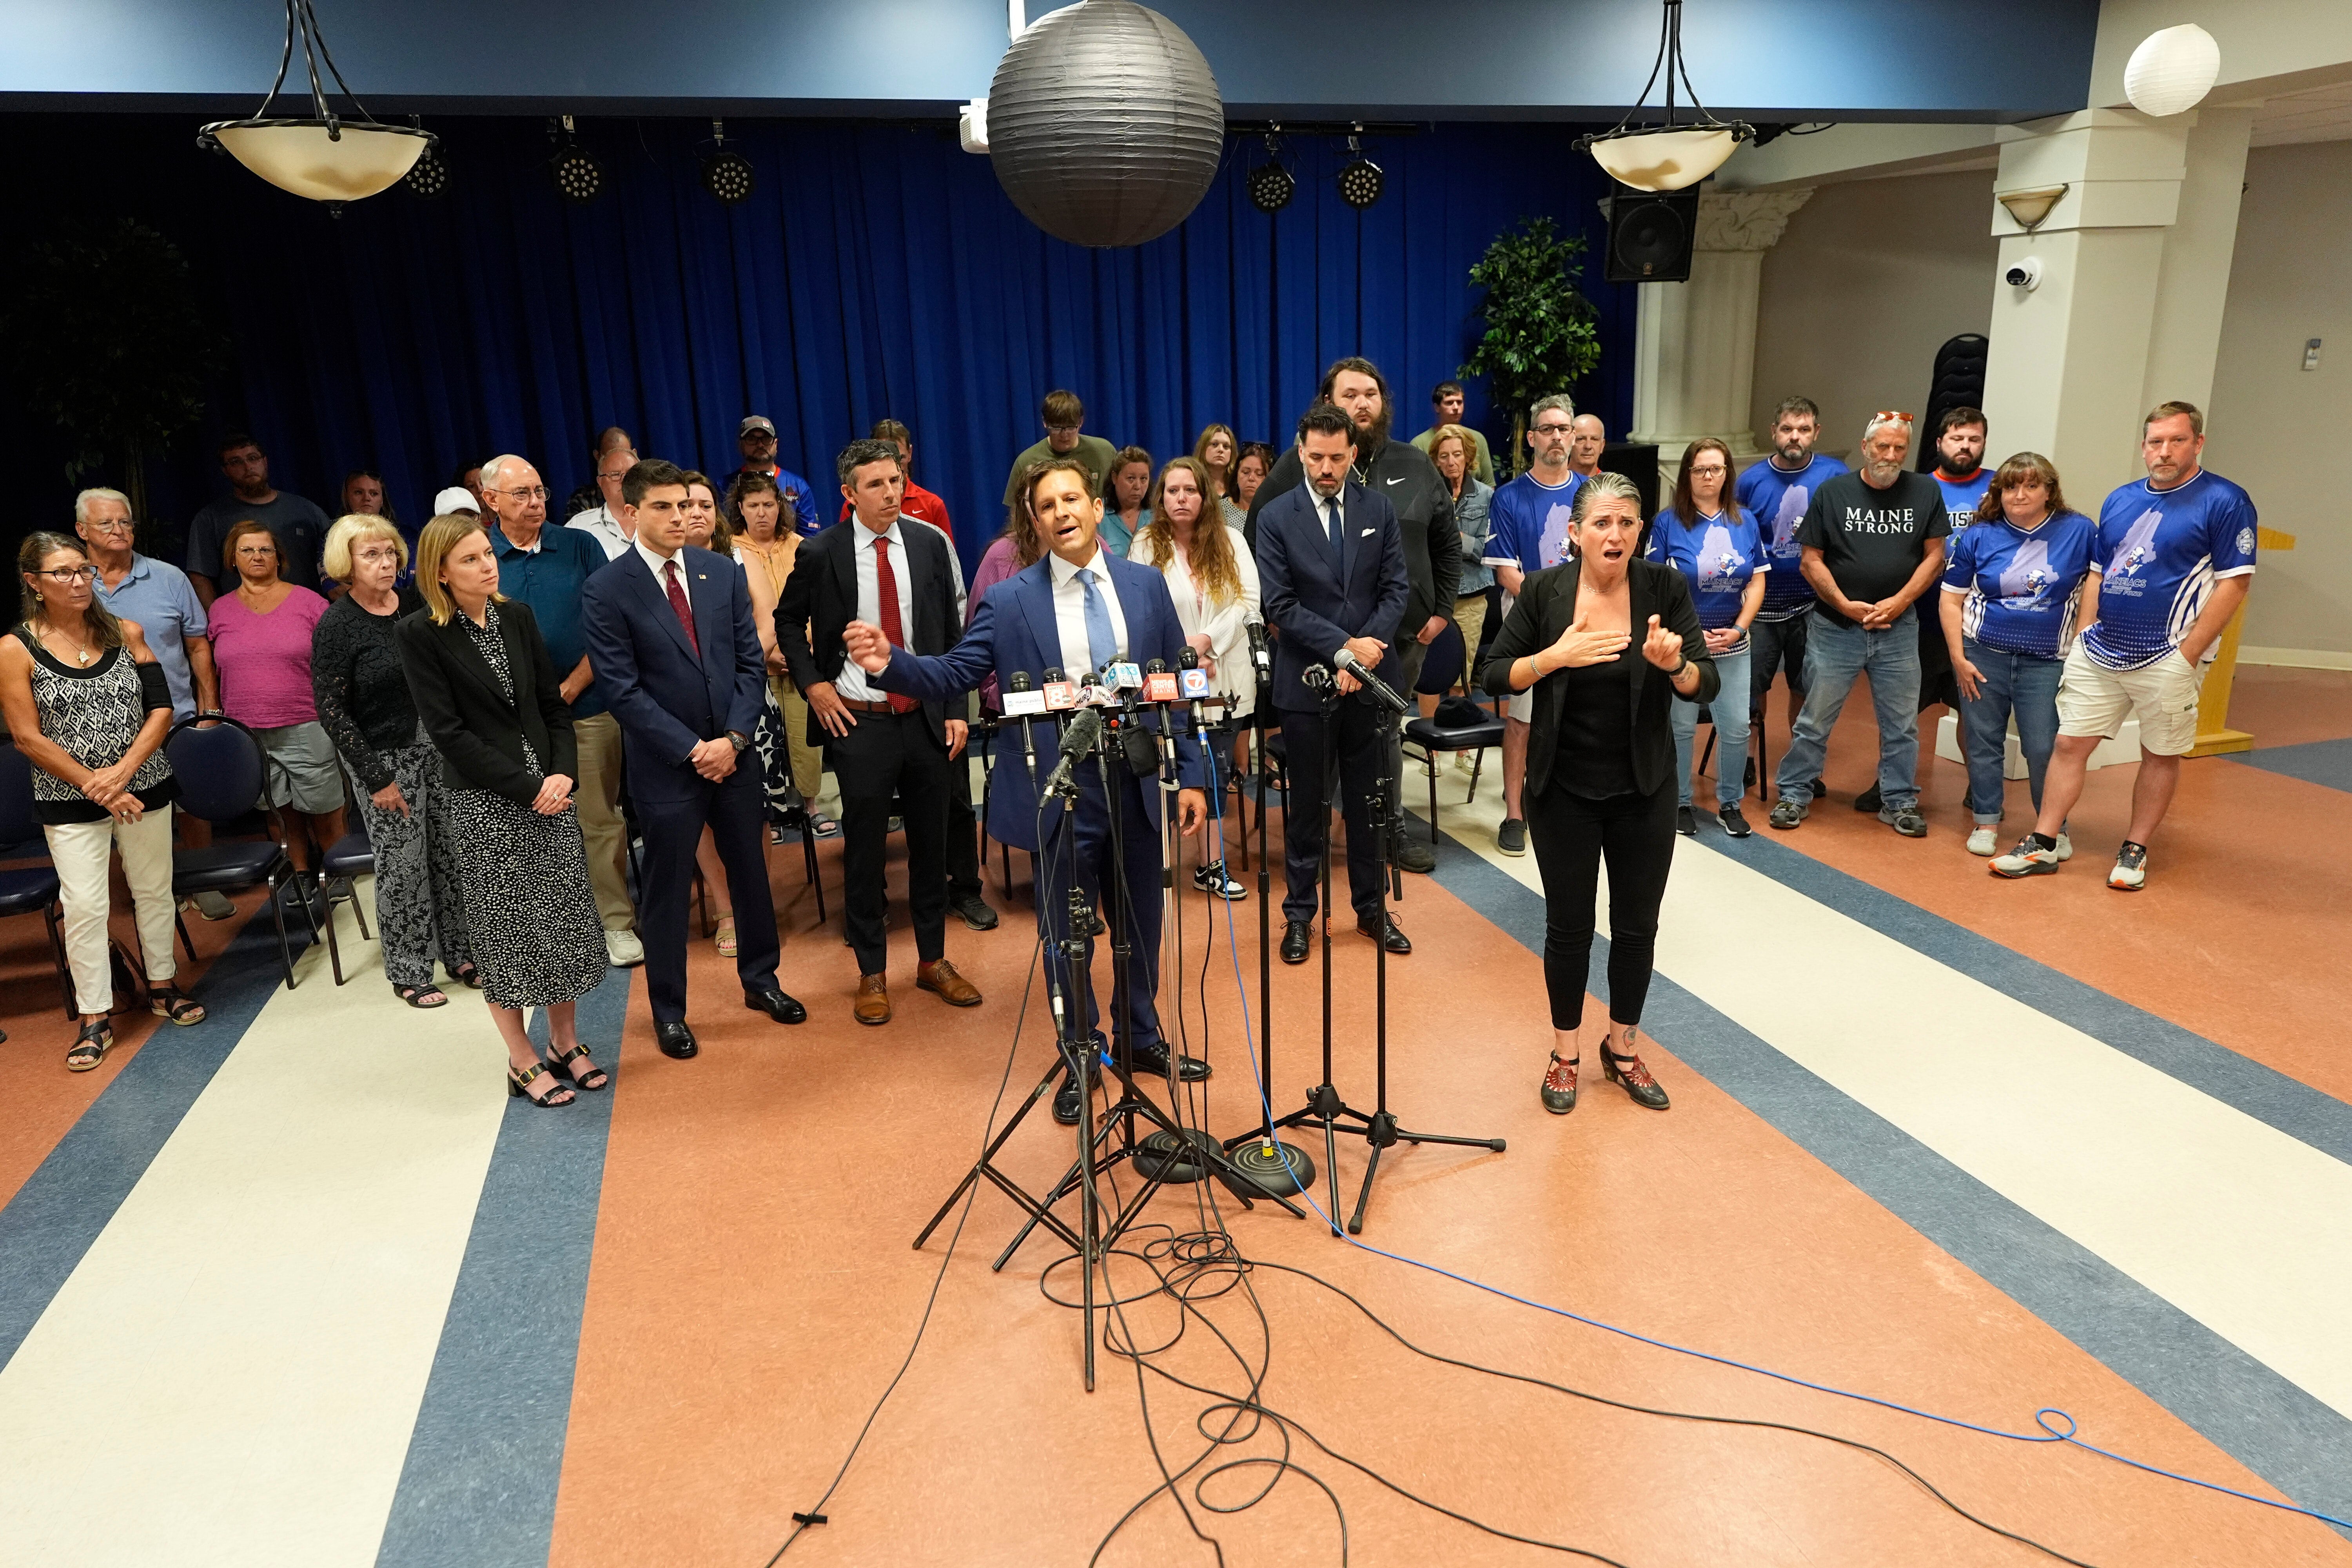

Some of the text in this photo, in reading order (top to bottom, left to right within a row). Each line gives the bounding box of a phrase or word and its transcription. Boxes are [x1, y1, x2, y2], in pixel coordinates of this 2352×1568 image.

[1846, 506, 1914, 523] MAINE
[1845, 520, 1913, 534] STRONG
[1108, 668, 1116, 681] 13
[1125, 666, 1138, 675] 13
[1188, 675, 1202, 688] 7
[1050, 690, 1063, 706] 8
[1097, 689, 1111, 701] WMUR
